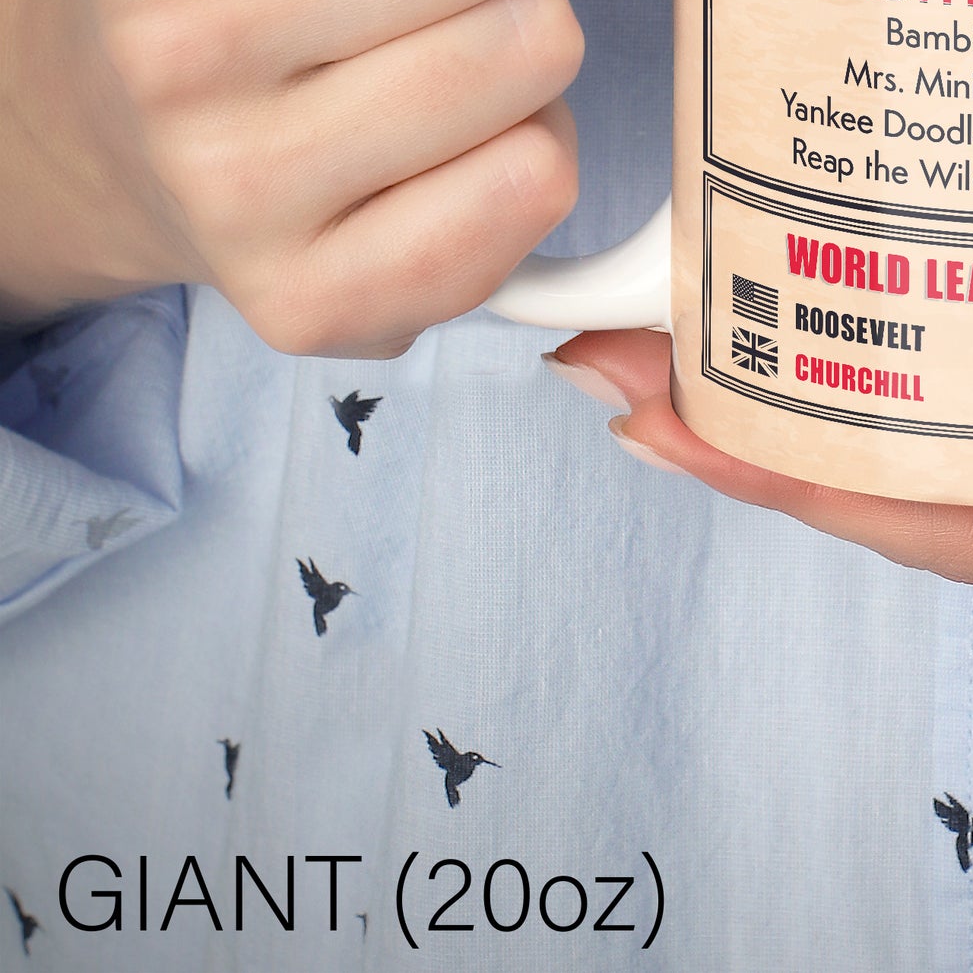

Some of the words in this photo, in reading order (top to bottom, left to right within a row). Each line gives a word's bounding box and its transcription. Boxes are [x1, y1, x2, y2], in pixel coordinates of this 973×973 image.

[844, 57, 904, 93] Mrs.
[780, 88, 874, 135] Yankee
[792, 137, 854, 183] Reap
[865, 150, 909, 184] the
[785, 233, 910, 296] WORLD
[794, 302, 926, 353] ROOSEVELT
[794, 353, 925, 402] CHURCHILL
